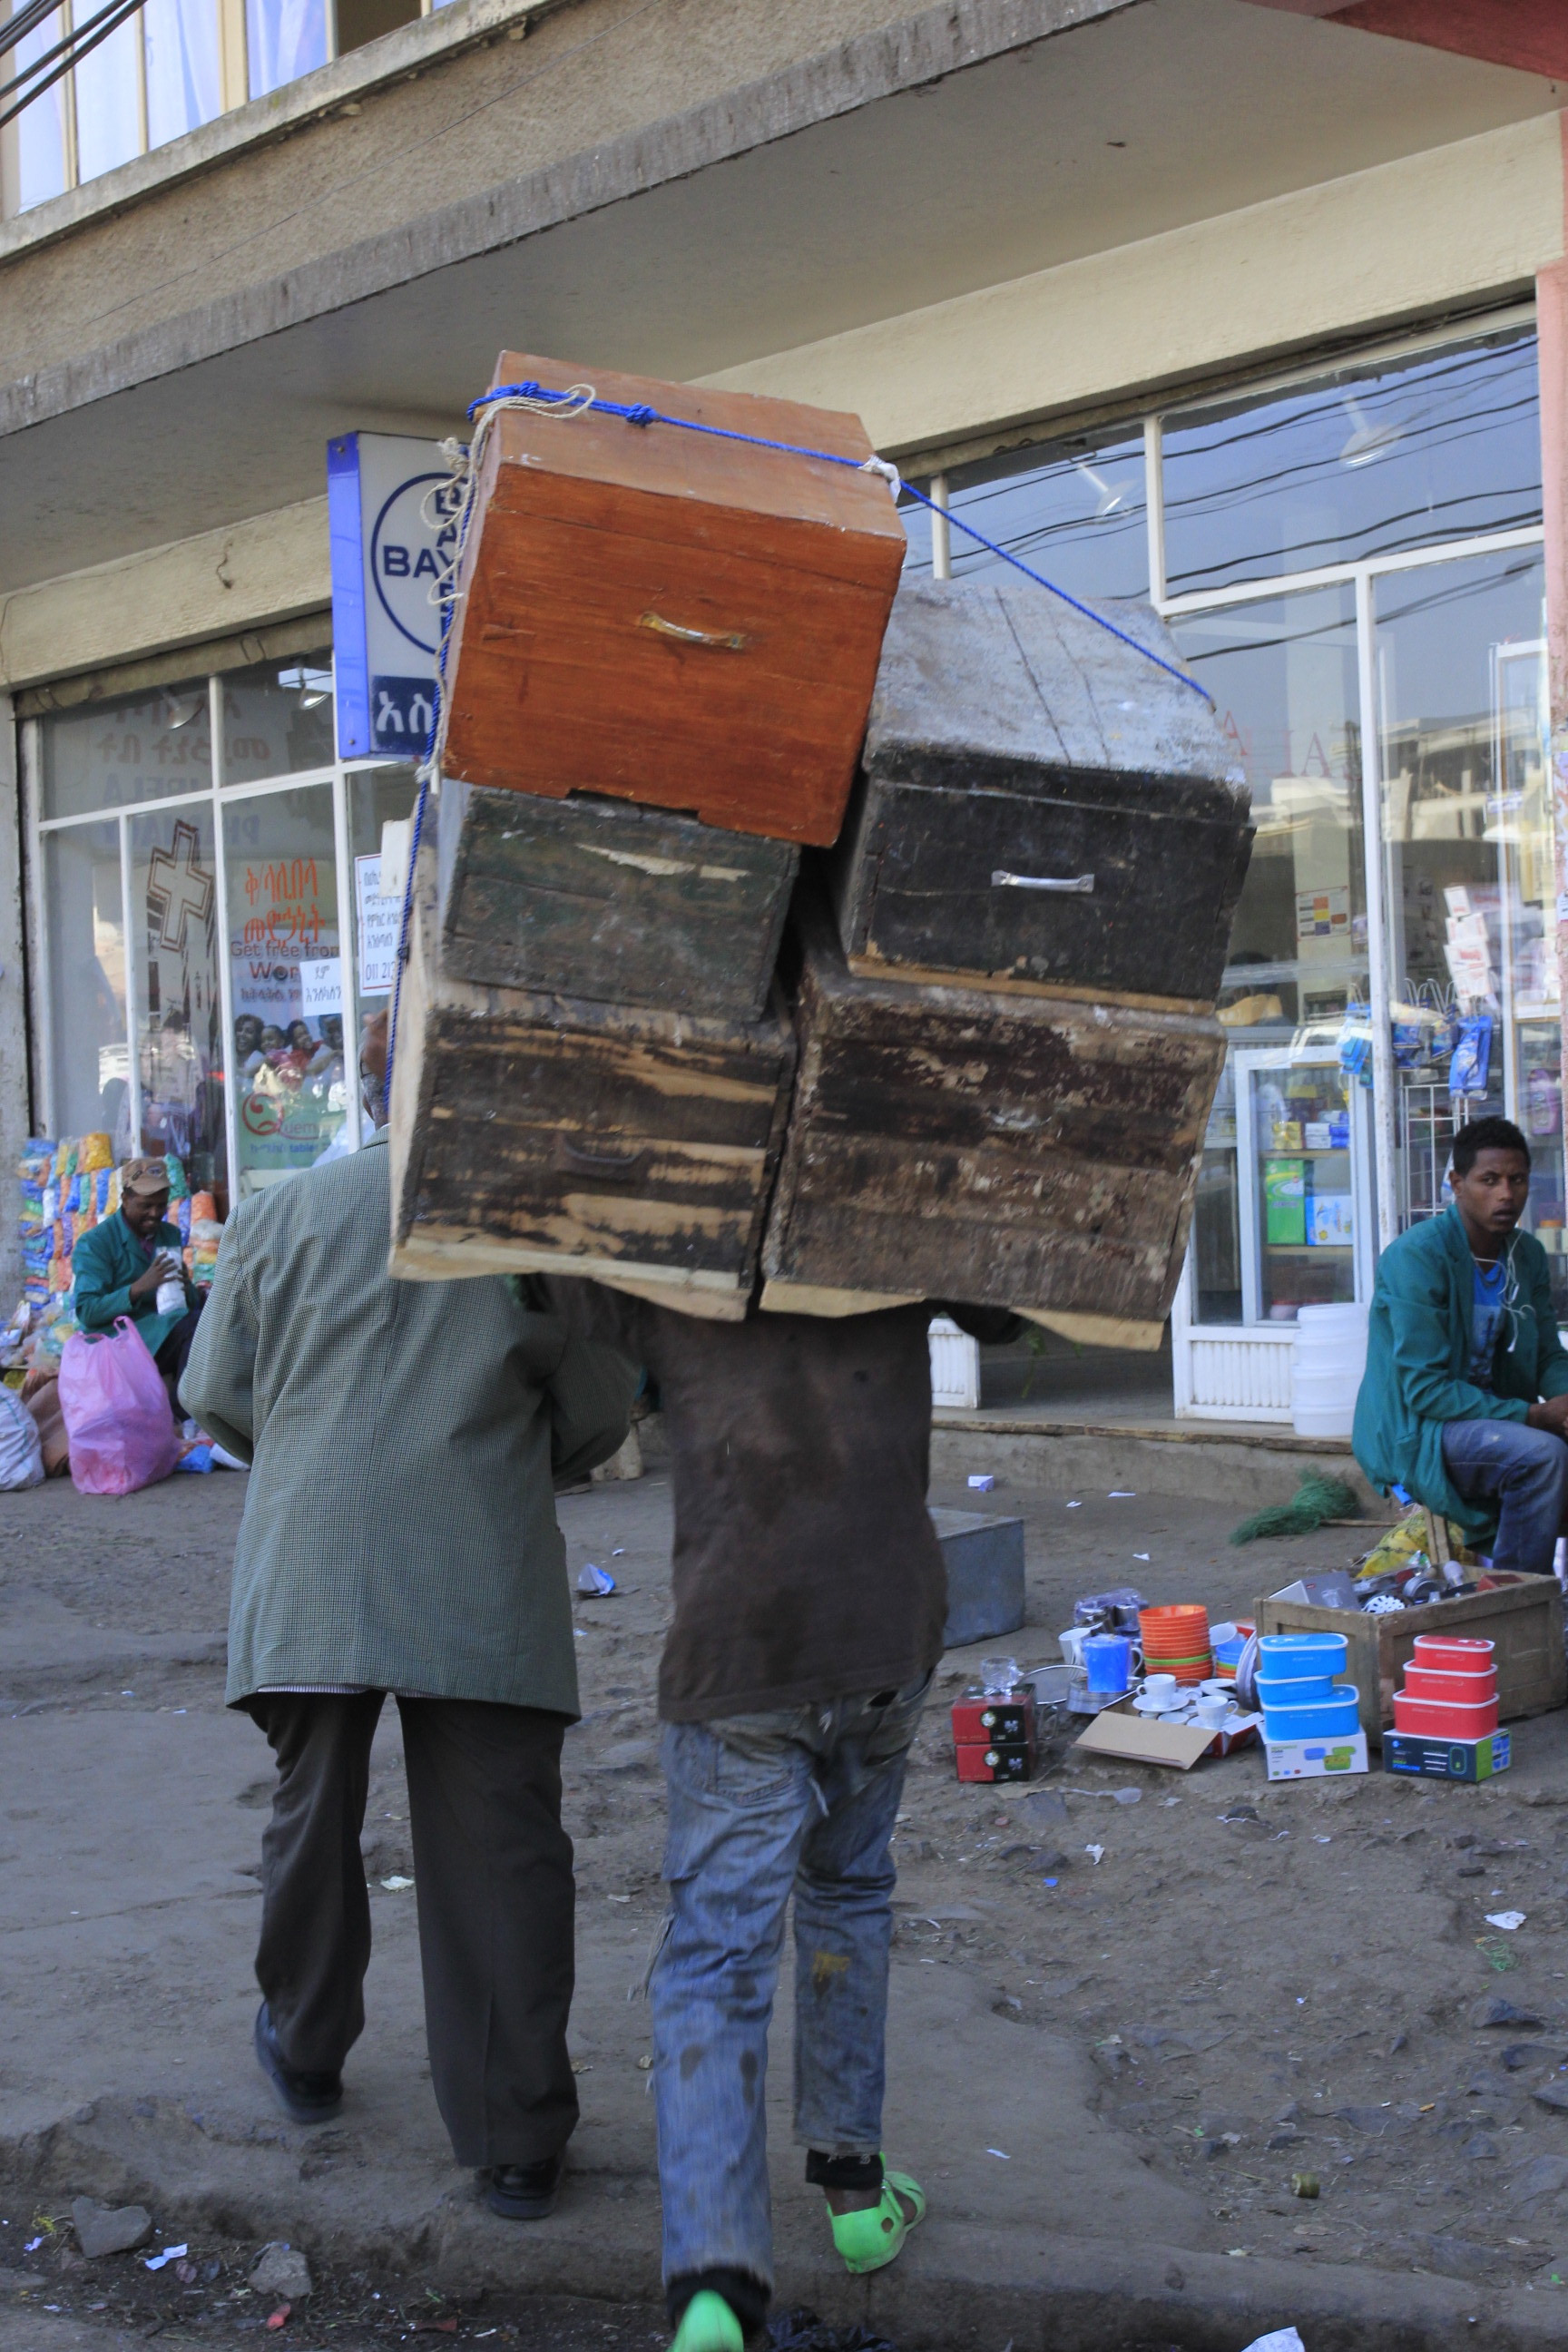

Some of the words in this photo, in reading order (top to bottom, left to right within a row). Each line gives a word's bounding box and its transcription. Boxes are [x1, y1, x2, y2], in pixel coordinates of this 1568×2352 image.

[230, 941, 261, 958] Get
[266, 940, 299, 958] free
[365, 963, 378, 981] 011
